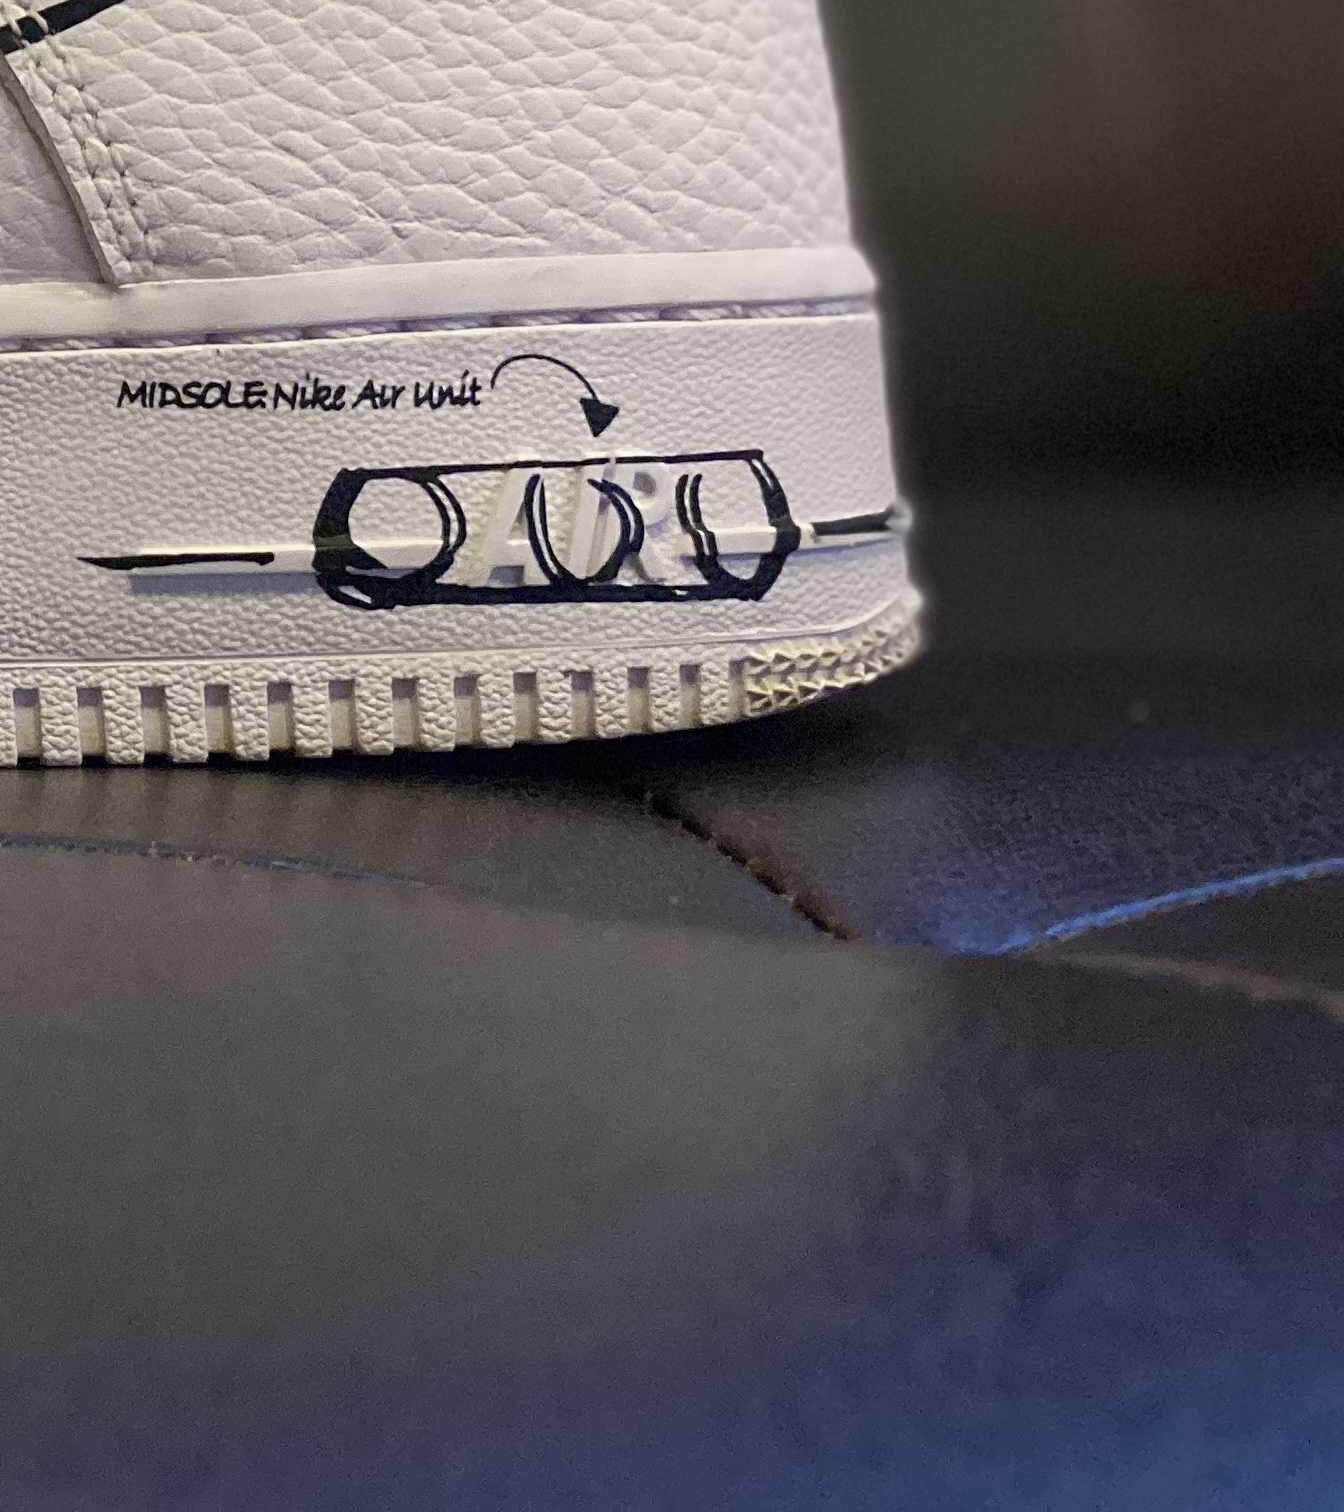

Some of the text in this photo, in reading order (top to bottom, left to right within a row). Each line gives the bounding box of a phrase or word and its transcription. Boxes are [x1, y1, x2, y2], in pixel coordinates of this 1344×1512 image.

[273, 372, 346, 411] Nike
[352, 378, 405, 409] Air
[413, 369, 482, 410] Unit
